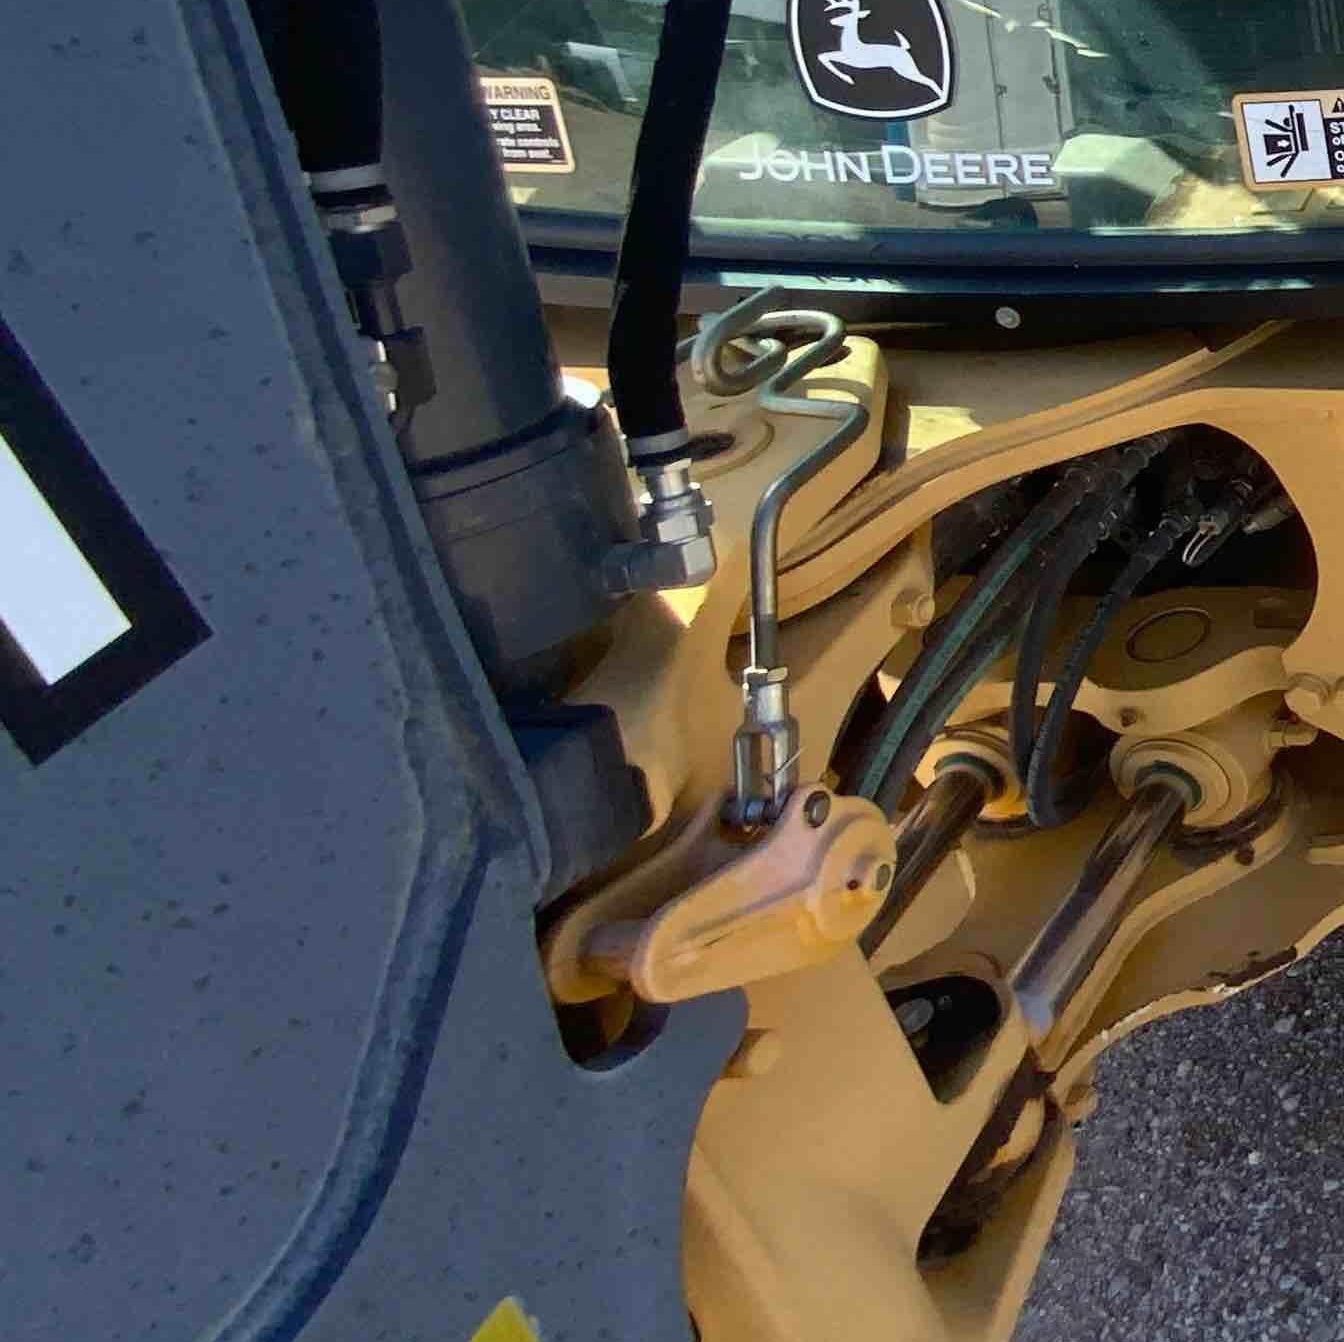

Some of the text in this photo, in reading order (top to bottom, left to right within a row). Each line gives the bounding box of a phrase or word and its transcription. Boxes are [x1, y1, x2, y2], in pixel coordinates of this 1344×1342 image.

[1332, 133, 1344, 145] of
[738, 140, 1055, 186] JOHN DEERE
